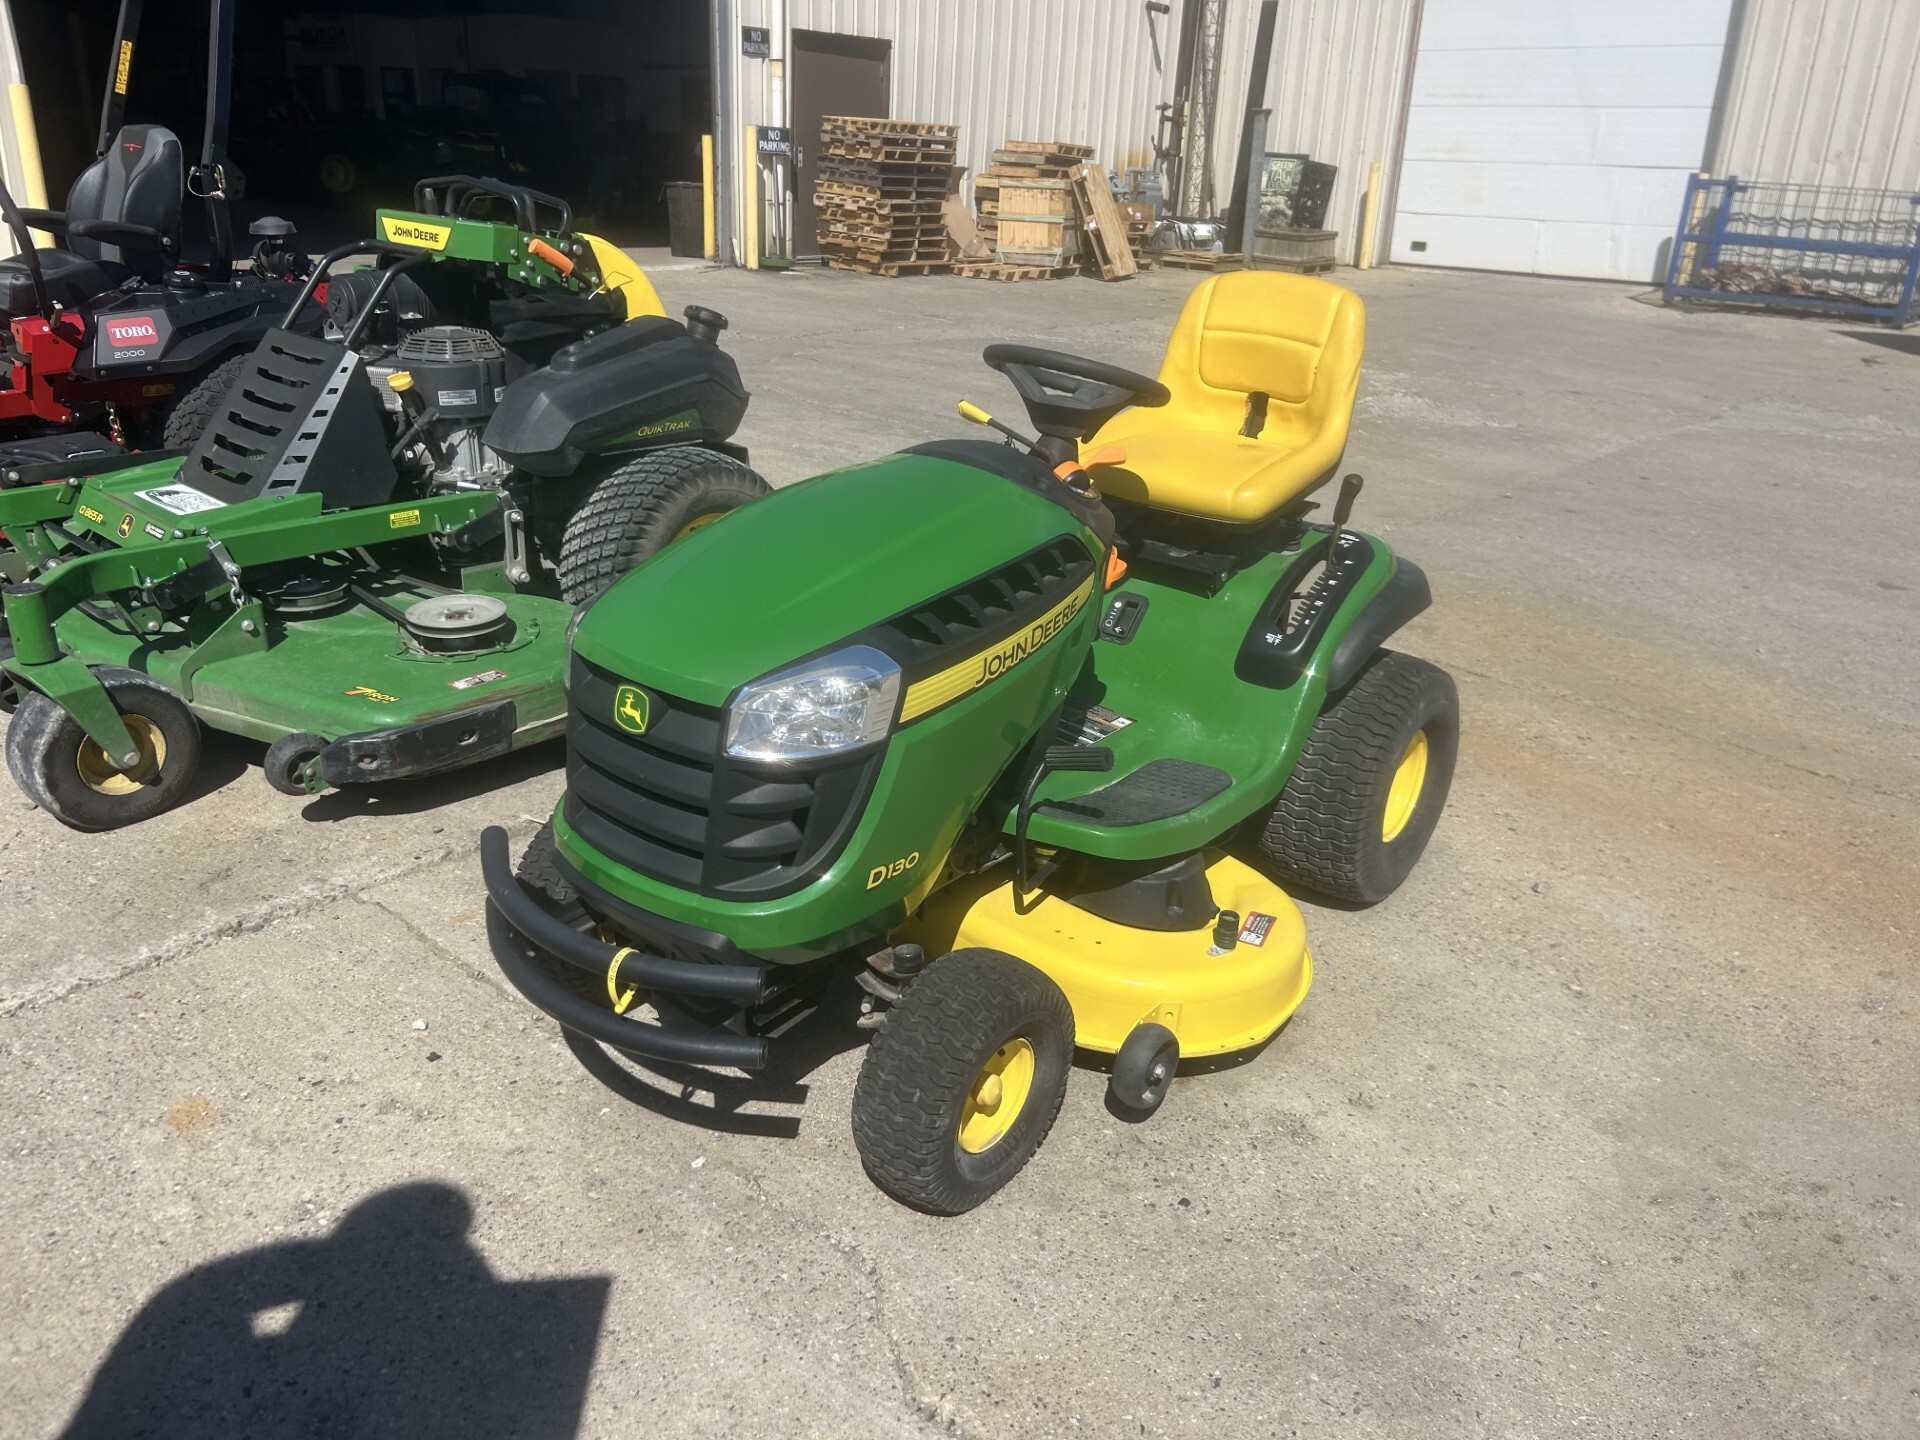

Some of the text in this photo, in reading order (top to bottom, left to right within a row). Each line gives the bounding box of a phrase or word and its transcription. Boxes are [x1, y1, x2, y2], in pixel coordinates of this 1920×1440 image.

[751, 30, 761, 42] NO
[743, 41, 769, 54] PARKING
[768, 129, 780, 141] NO
[760, 140, 790, 152] PARKING
[393, 225, 440, 243] JOHN DEERE
[111, 325, 153, 339] TORO
[114, 349, 146, 359] 2000
[975, 595, 1079, 687] JOHN DEERE
[866, 851, 920, 891] D130
